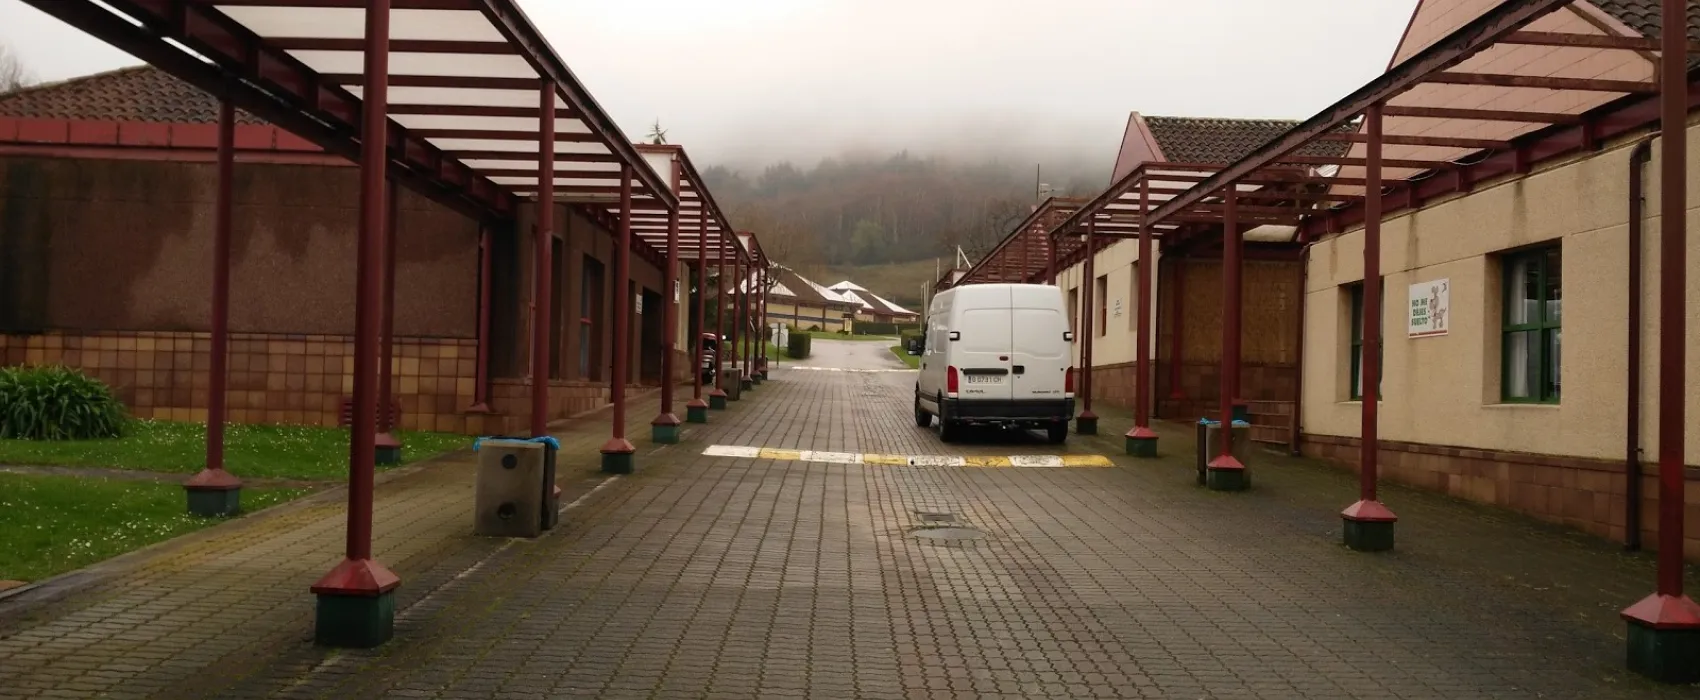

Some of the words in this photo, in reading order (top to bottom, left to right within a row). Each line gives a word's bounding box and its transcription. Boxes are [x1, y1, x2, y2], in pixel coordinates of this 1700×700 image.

[1412, 299, 1419, 307] NO
[1420, 298, 1427, 306] ME
[1411, 317, 1427, 326] SUELTO
